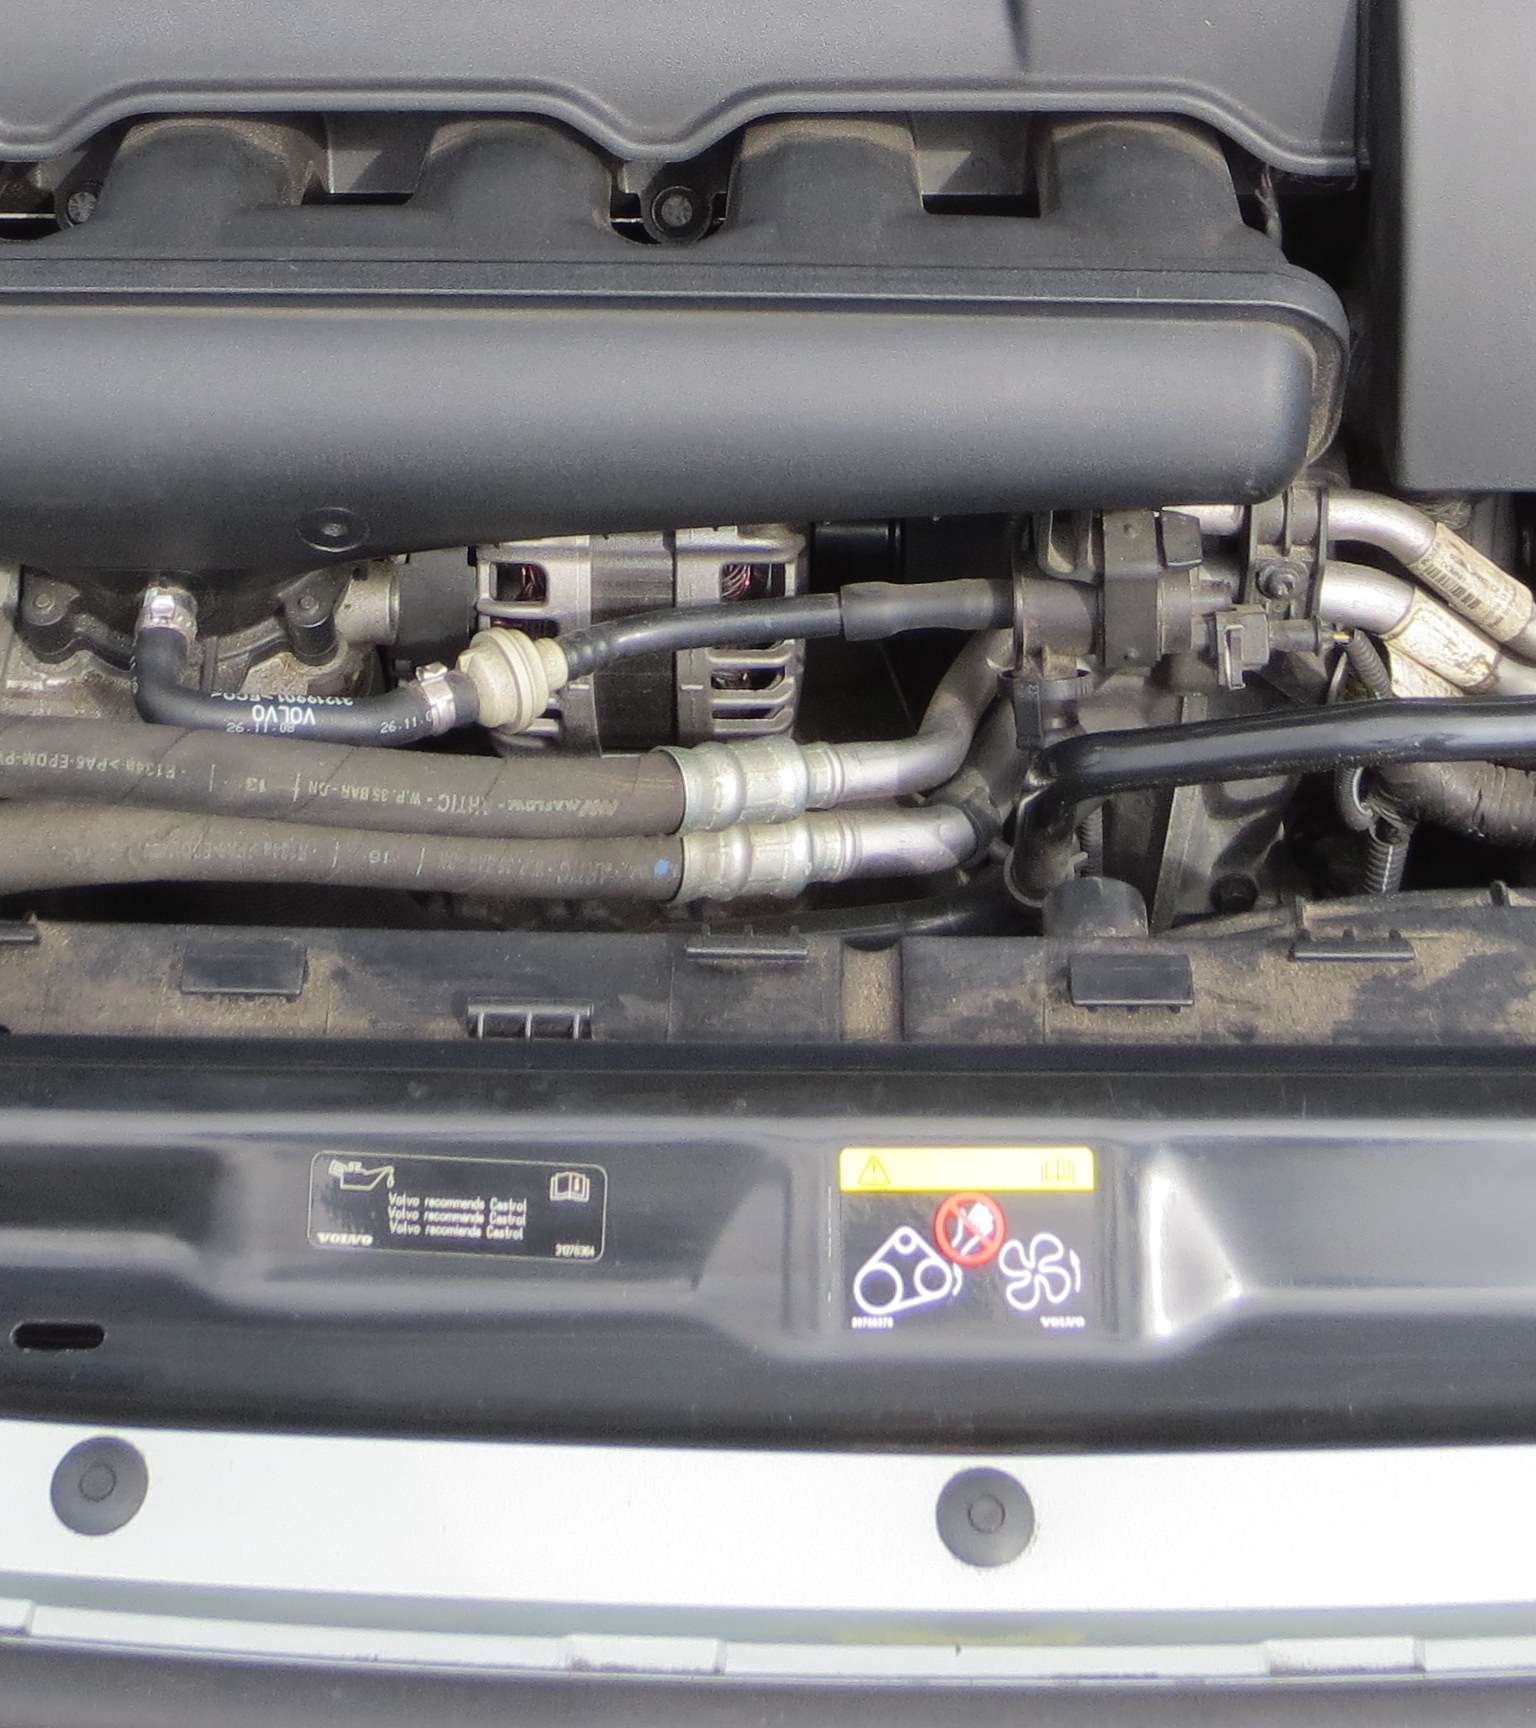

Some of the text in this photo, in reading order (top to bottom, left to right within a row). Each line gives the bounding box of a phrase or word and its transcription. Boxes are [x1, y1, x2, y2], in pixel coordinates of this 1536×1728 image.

[252, 705, 317, 726] VOLVO
[389, 1192, 420, 1208] Volvo
[490, 1197, 527, 1213] Castrol
[388, 1206, 419, 1222] Volvo
[489, 1212, 527, 1227] Castrol
[317, 1232, 373, 1246] VOLVO
[389, 1221, 421, 1236] Volvo
[486, 1226, 524, 1241] Castrol
[1040, 1316, 1085, 1328] VOLVO
